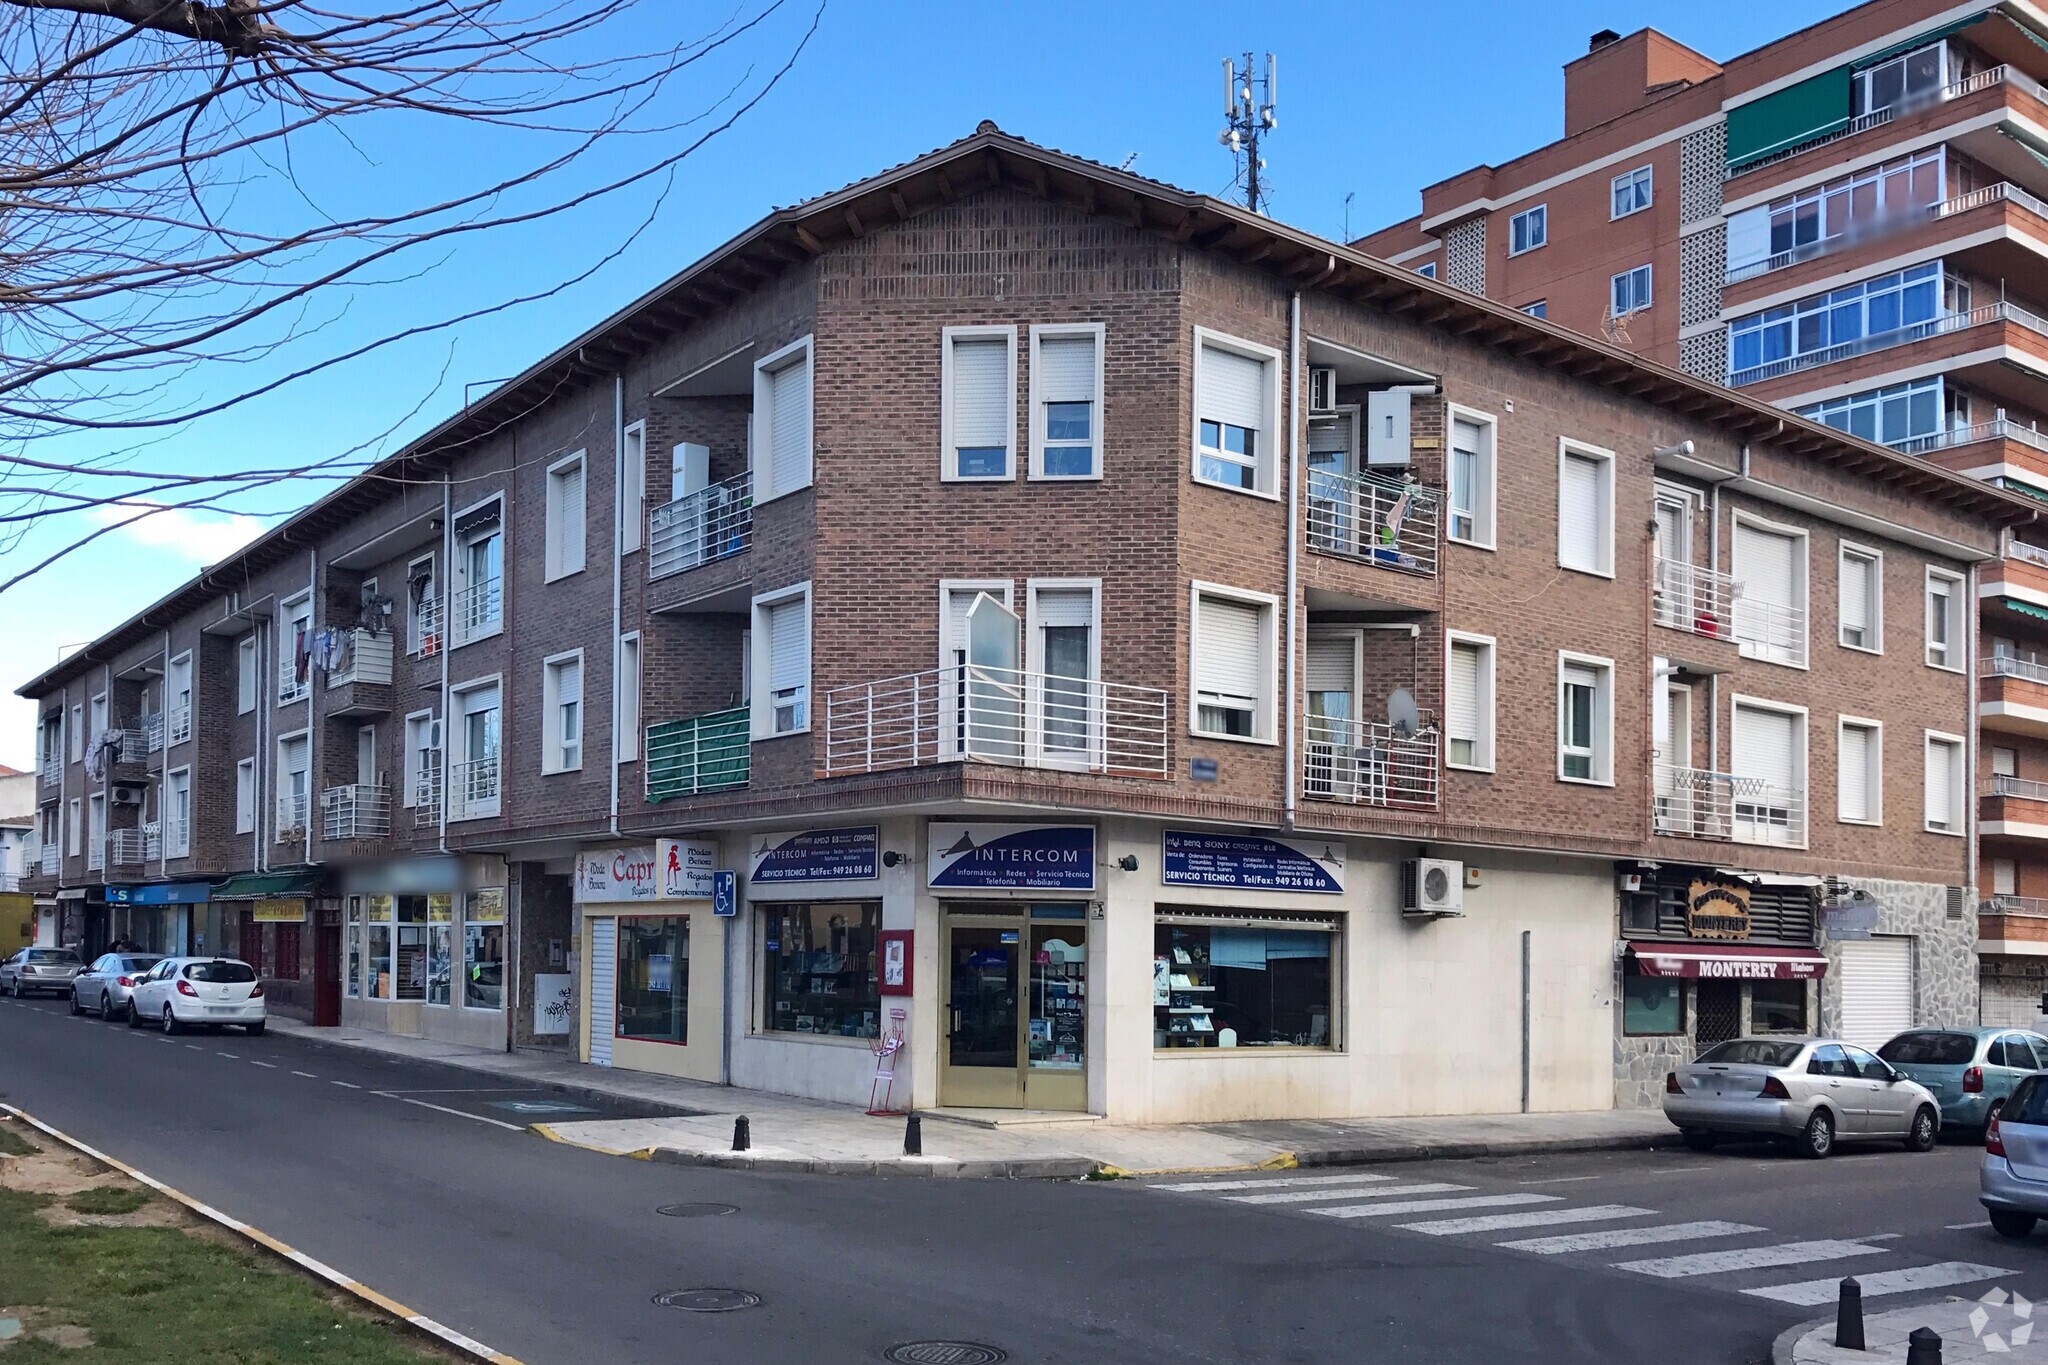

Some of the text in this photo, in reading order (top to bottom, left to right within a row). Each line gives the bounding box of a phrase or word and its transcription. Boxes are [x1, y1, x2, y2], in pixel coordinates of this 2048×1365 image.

[688, 848, 712, 856] Modas
[768, 850, 806, 860] INTERCOM
[975, 849, 1078, 863] INTERCOM
[686, 871, 713, 881] Regalos
[761, 869, 783, 878] SERVICIO
[785, 868, 806, 876] TÉCNICO
[833, 866, 844, 875] 949
[845, 866, 853, 874] 26
[854, 865, 862, 874] 08
[864, 865, 872, 873] 60
[726, 874, 732, 891] P
[1166, 871, 1200, 880] SERVICIO
[1203, 872, 1236, 882] TÉCNICO
[1243, 875, 1273, 884] Tel/Fax:
[1275, 877, 1290, 885] 949
[1304, 878, 1313, 886] 08
[1316, 879, 1325, 887] 60
[667, 888, 713, 897] Complementos
[1692, 915, 1748, 931] MONTEREY
[1699, 961, 1778, 978] MONTEREY
